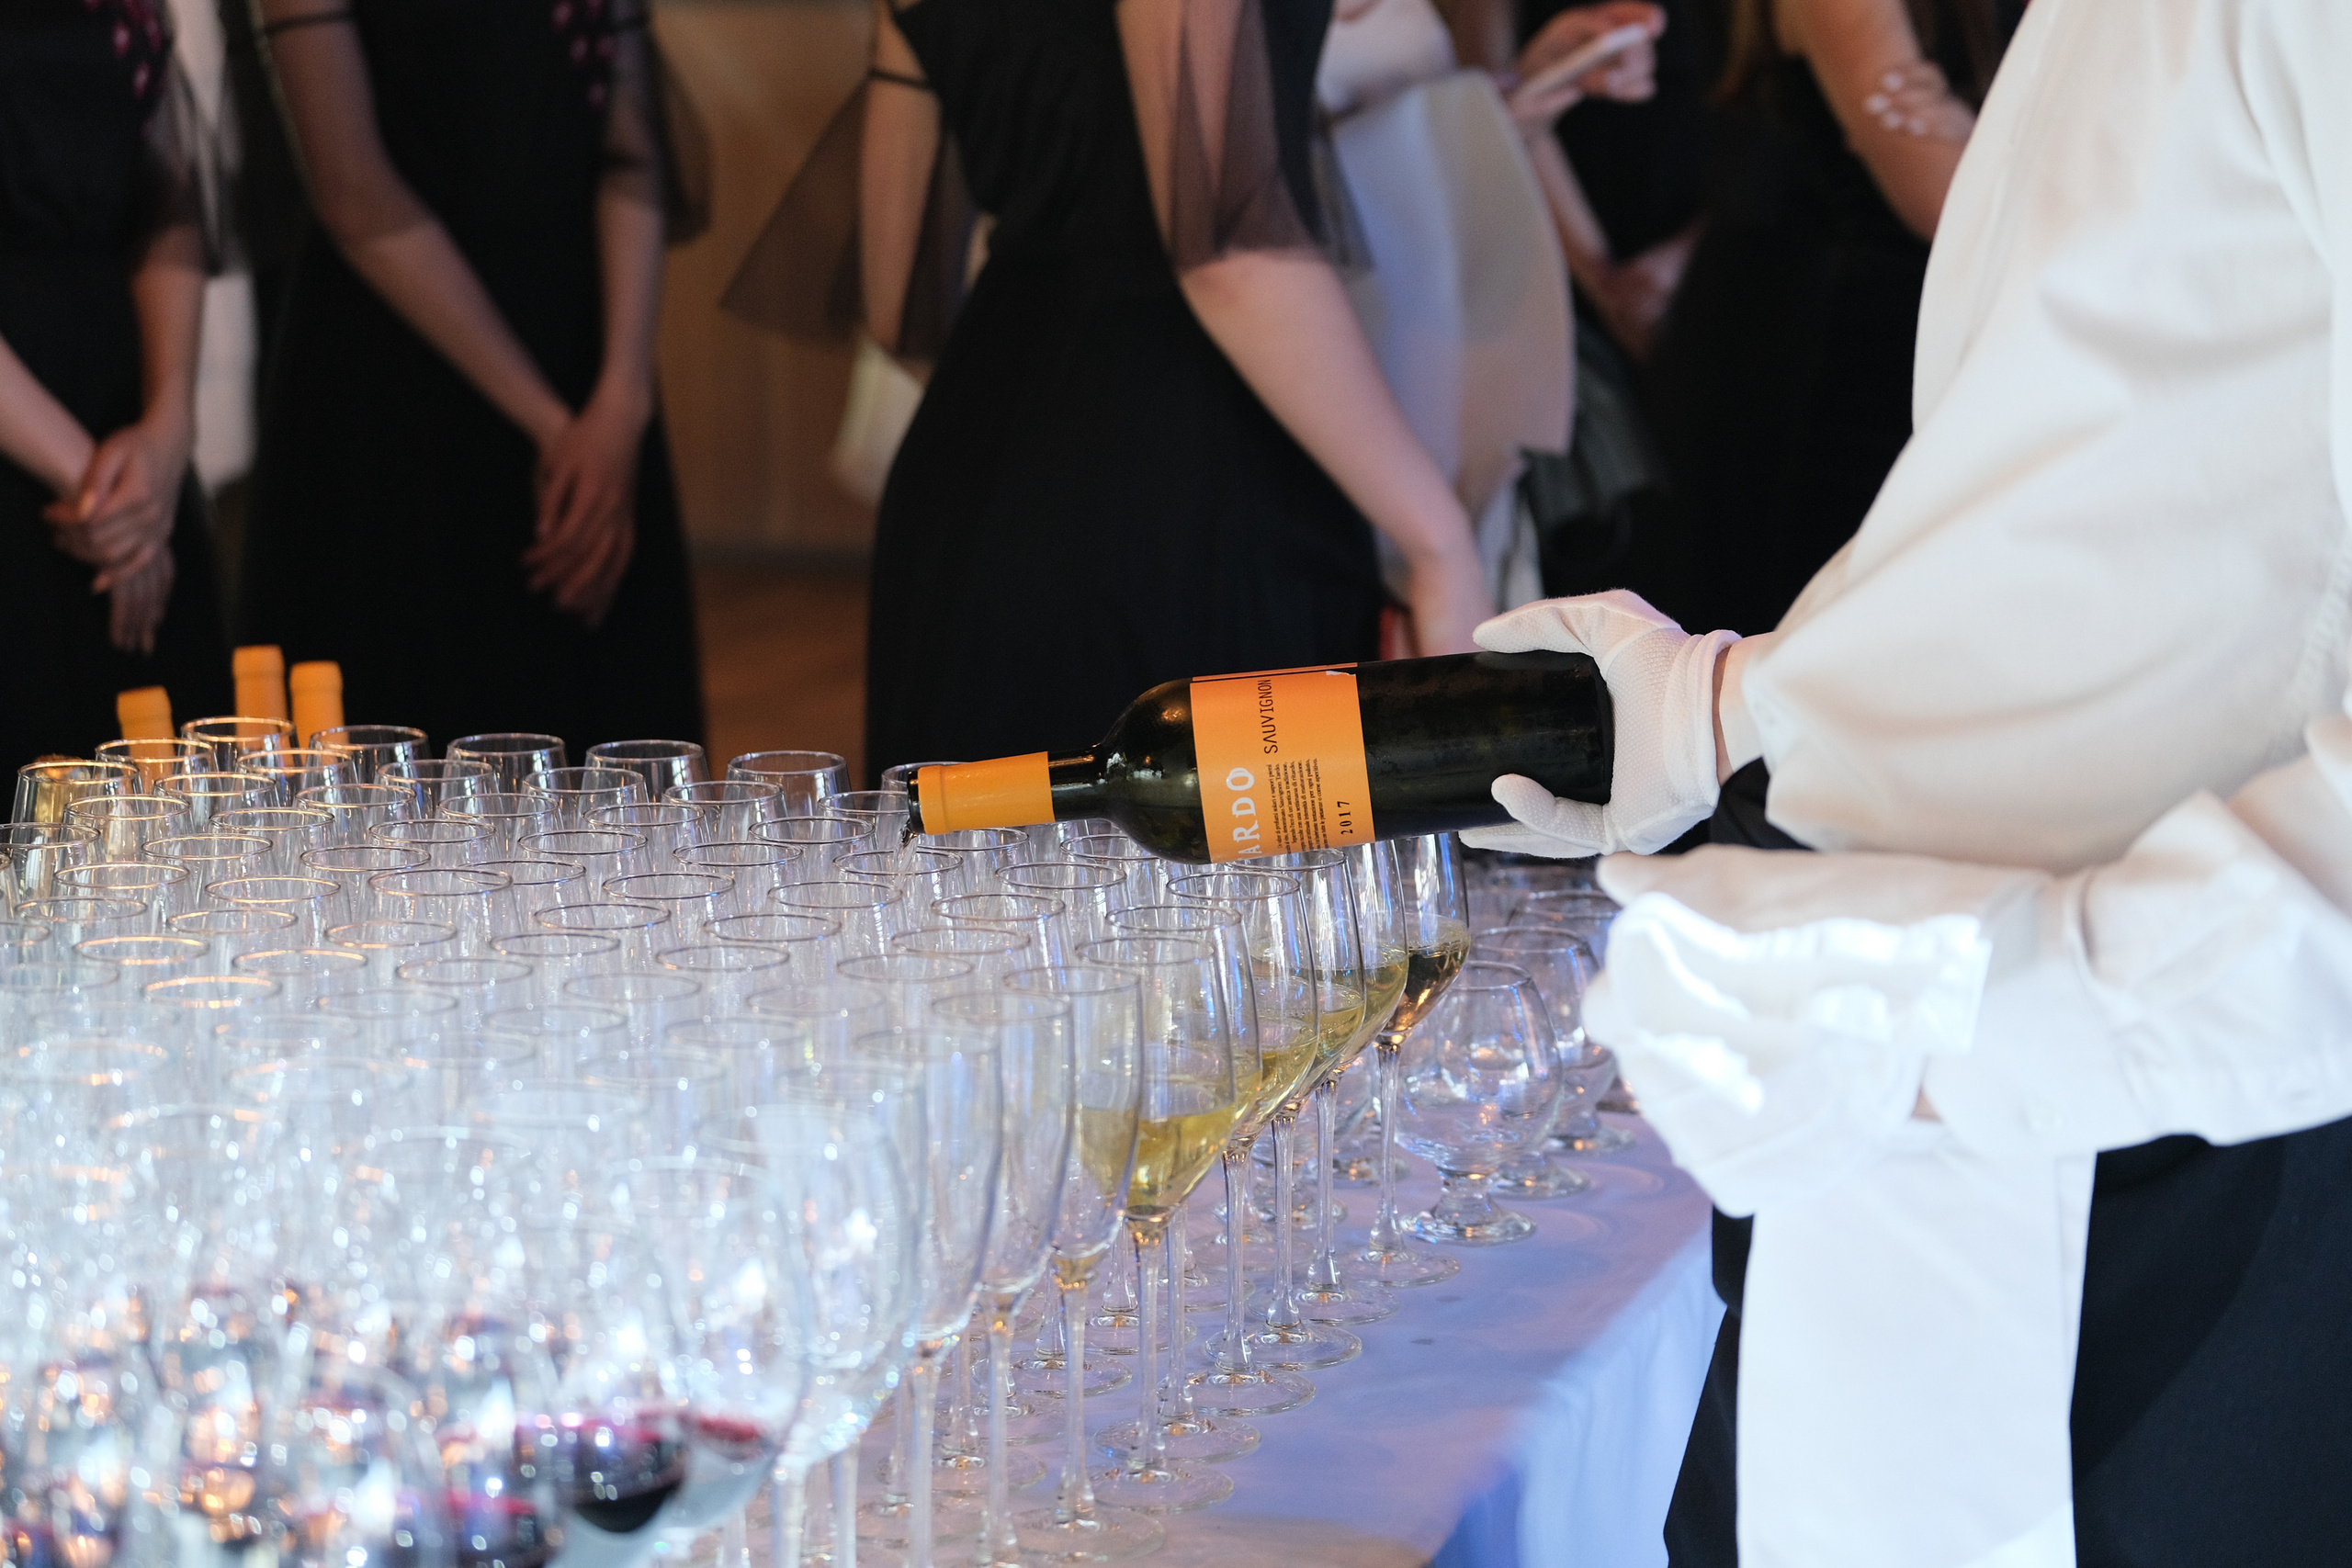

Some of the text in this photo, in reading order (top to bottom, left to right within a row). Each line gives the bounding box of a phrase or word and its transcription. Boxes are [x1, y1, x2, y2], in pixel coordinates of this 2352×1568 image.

[1258, 679, 1278, 754] SAUVIGNON
[1226, 767, 1262, 861] ARDO
[1337, 800, 1353, 835] 2017
